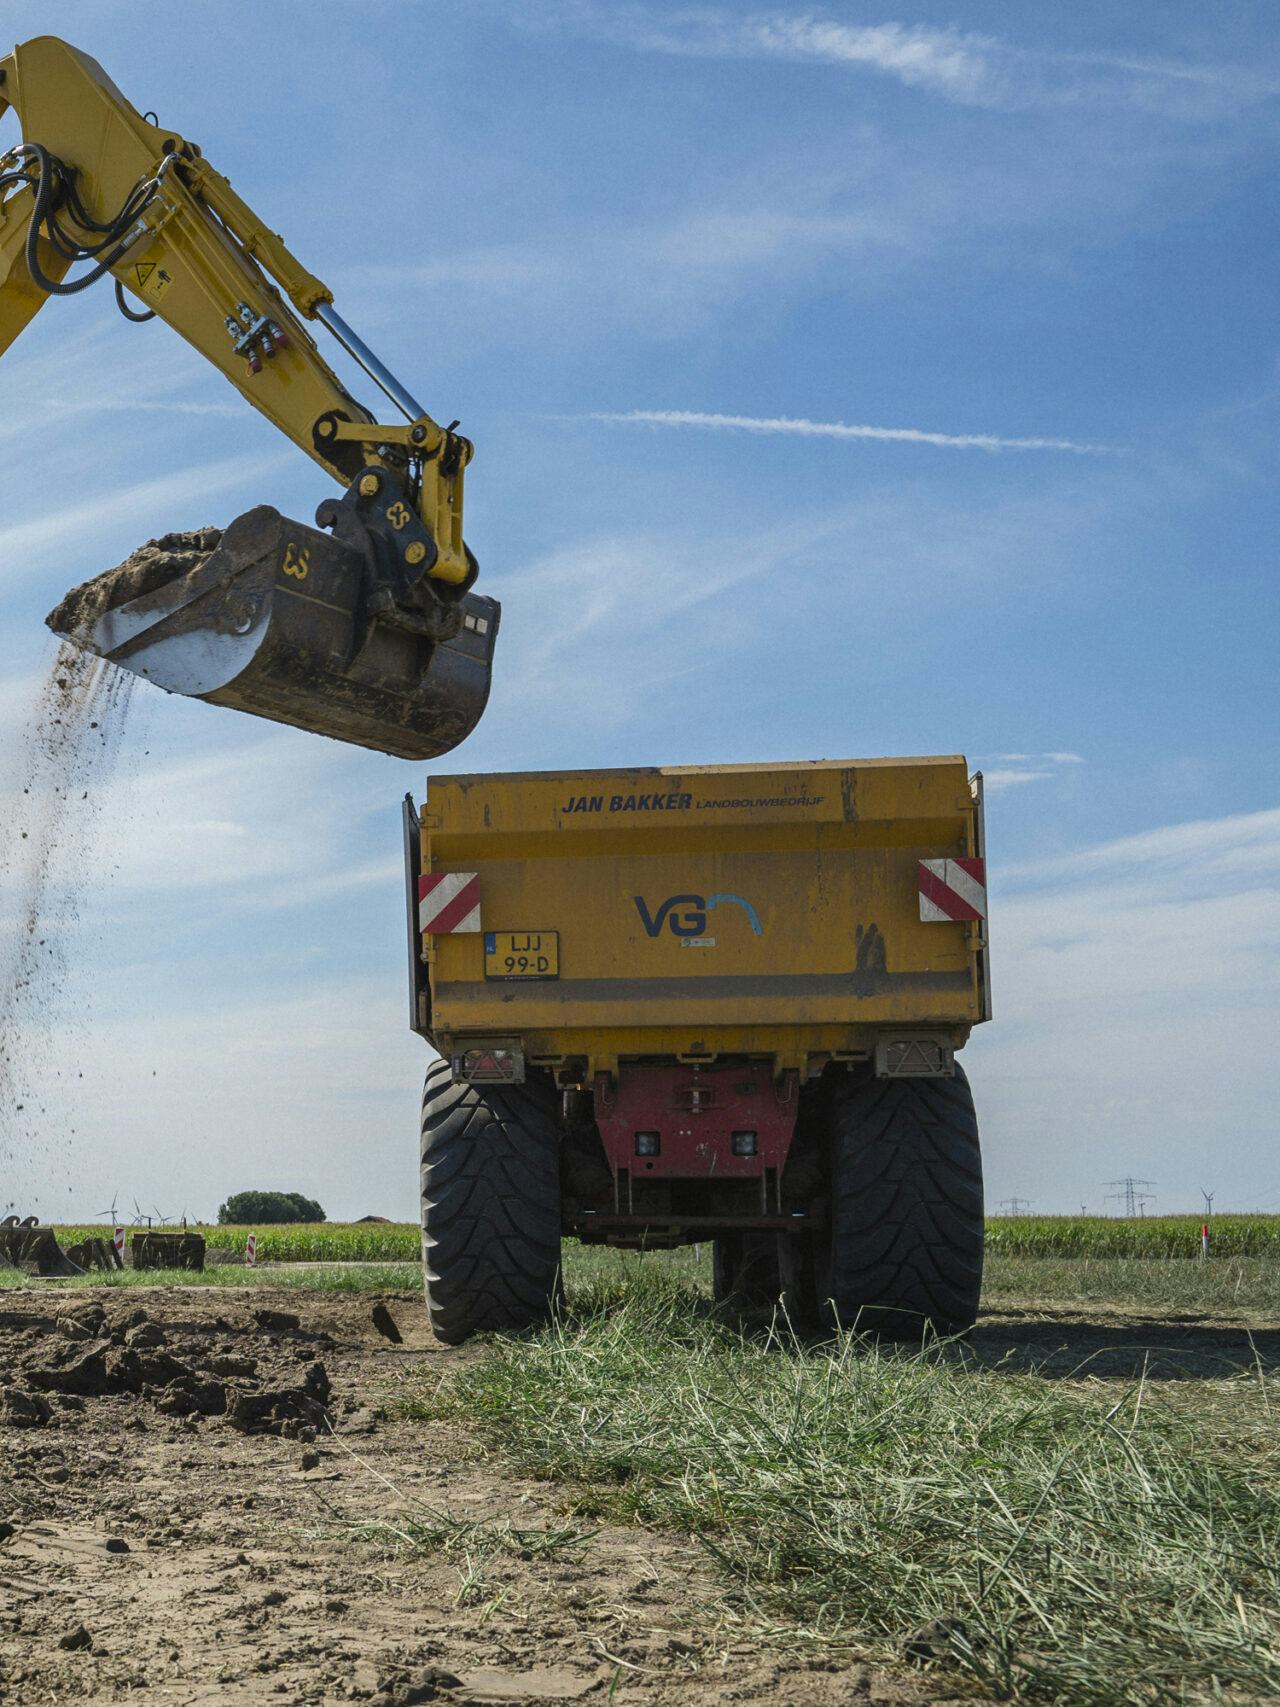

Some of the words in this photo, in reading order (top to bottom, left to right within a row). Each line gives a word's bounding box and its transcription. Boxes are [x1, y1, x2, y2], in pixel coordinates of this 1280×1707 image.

[562, 796, 604, 813] JAN
[609, 793, 693, 812] BAKKER
[696, 796, 825, 809] LANDBOUWBEDRIJF
[511, 935, 541, 951] LJJ
[504, 956, 549, 972] 99-D
